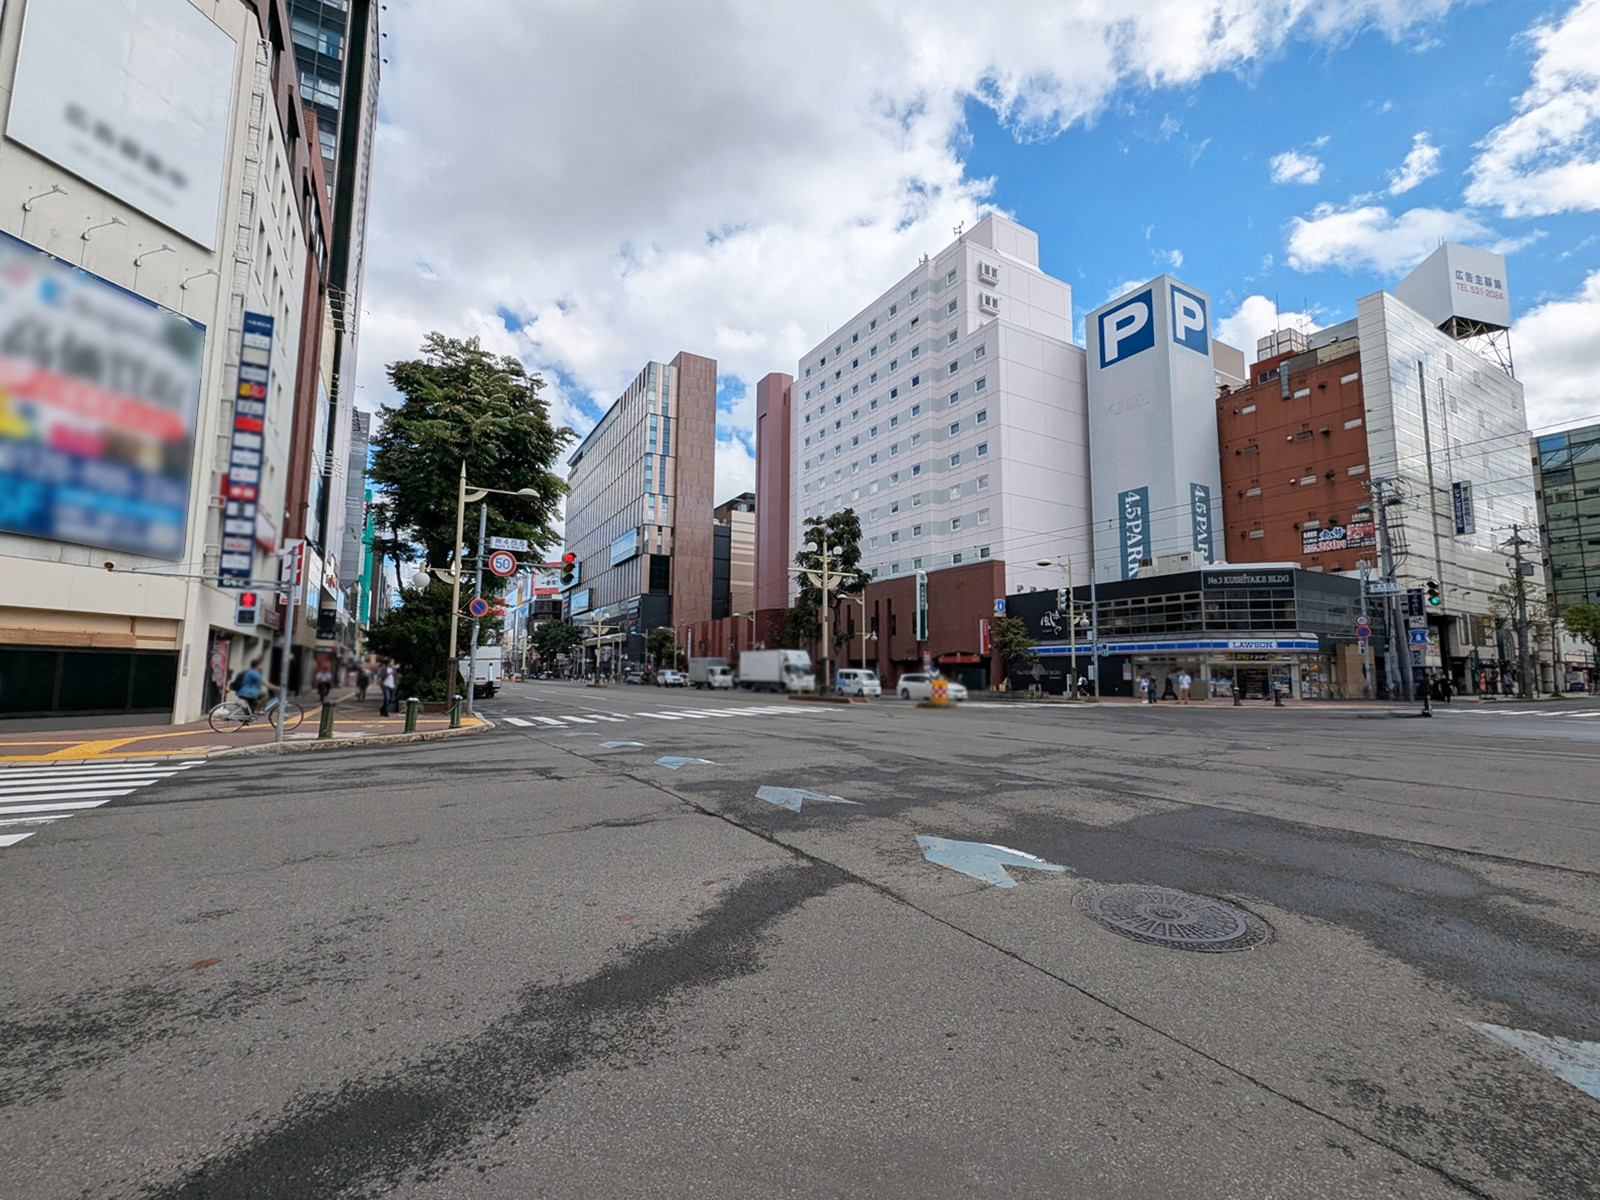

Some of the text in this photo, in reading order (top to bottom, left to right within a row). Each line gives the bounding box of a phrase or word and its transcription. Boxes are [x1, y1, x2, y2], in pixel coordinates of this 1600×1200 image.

[1455, 270, 1502, 289] 広告主募集
[1456, 282, 1470, 293] TEL
[1173, 290, 1205, 342] P
[1102, 301, 1149, 363] P
[1194, 485, 1209, 565] 4.5PAR
[495, 557, 511, 570] 50
[1268, 575, 1289, 583] BLDG
